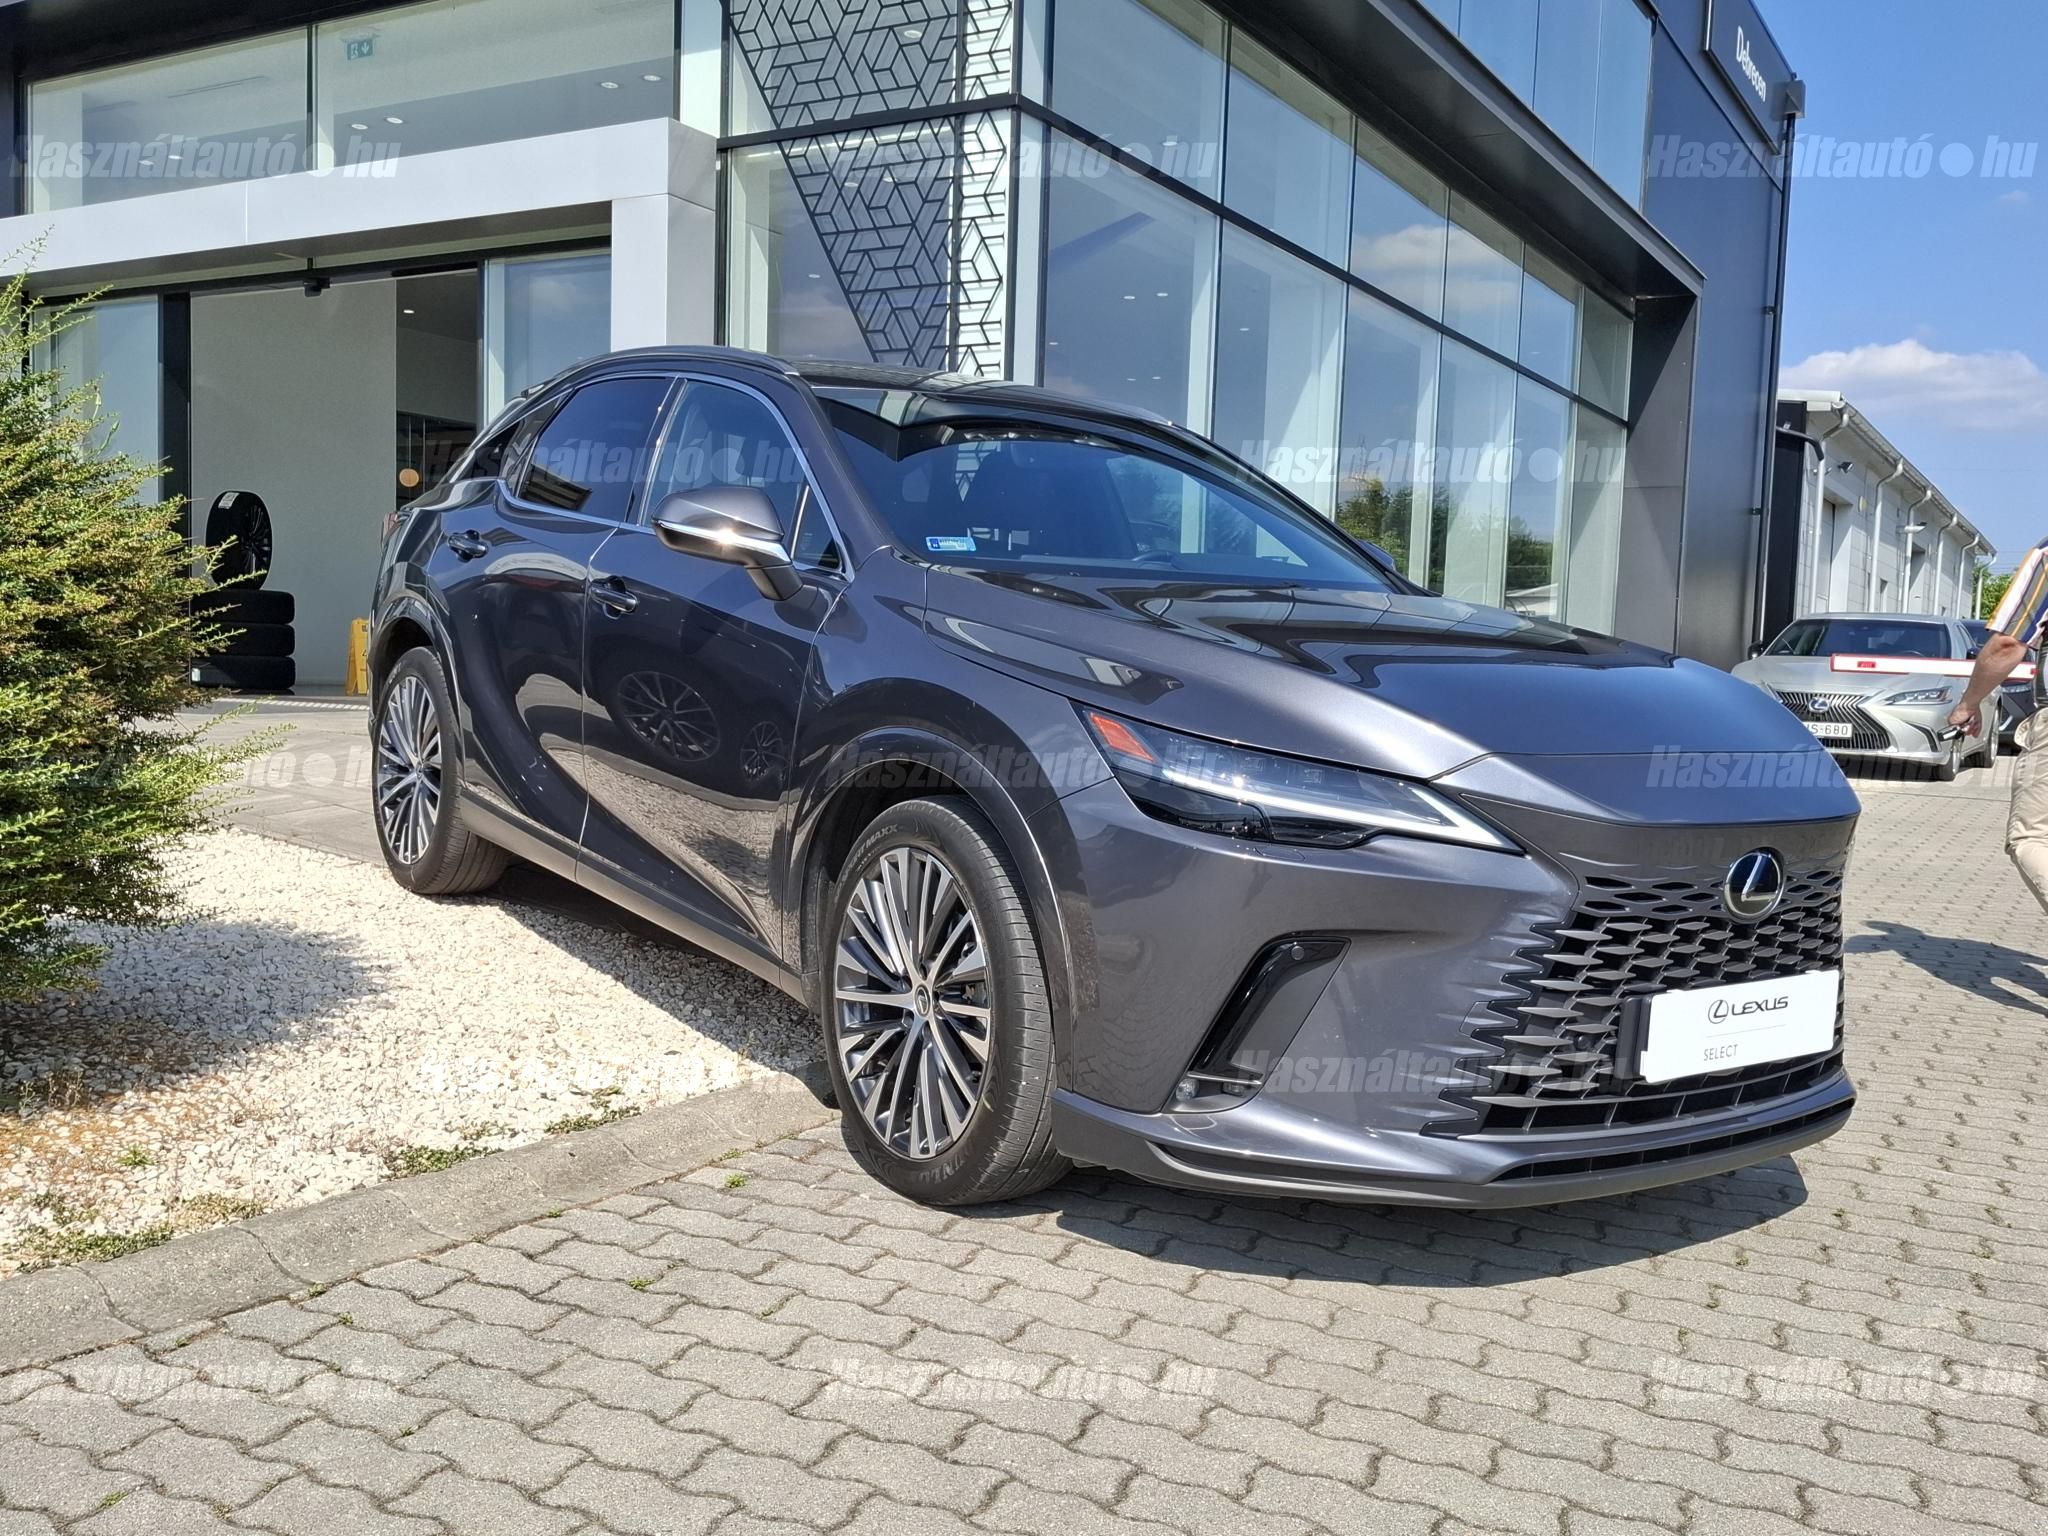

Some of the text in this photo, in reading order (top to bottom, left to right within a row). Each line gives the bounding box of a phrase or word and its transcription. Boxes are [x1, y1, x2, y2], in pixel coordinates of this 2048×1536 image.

[1736, 25, 1767, 102] Debrecen
[1807, 723, 1848, 736] S-680
[1731, 996, 1789, 1016] LEXUS
[1703, 1043, 1738, 1062] SELECT
